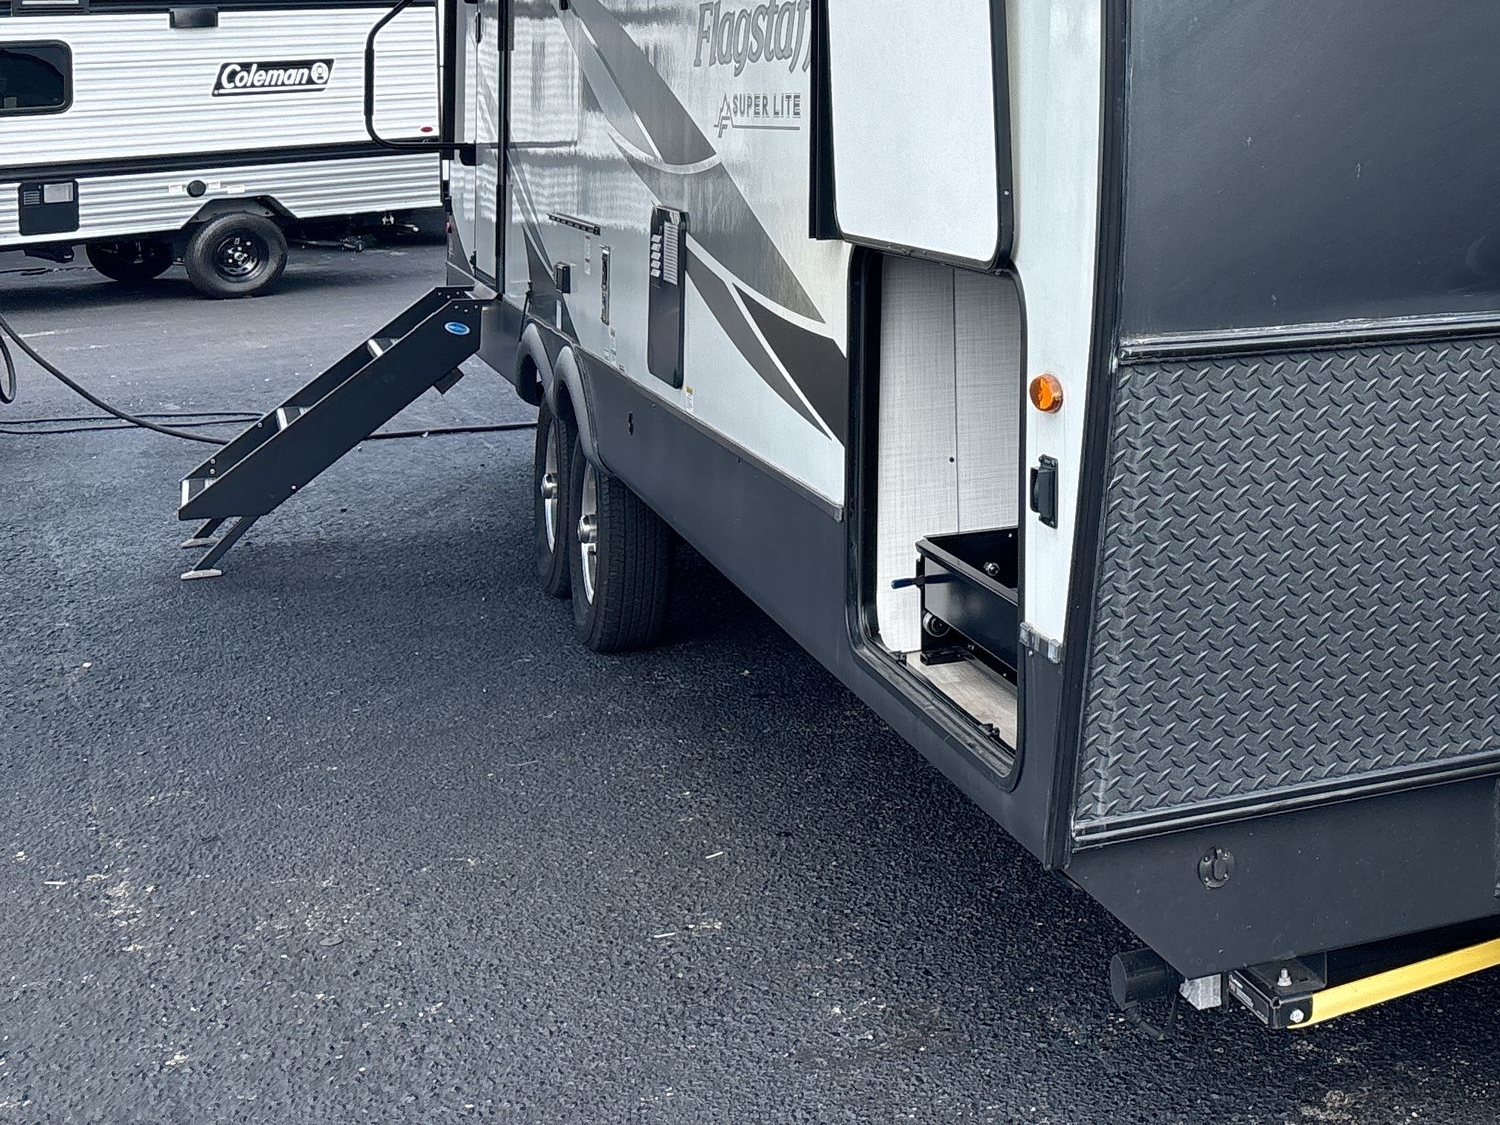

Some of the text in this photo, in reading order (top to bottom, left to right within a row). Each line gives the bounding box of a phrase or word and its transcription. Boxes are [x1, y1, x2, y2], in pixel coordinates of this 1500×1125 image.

[221, 63, 310, 89] Coleman
[732, 93, 801, 118] SUPER LITE
